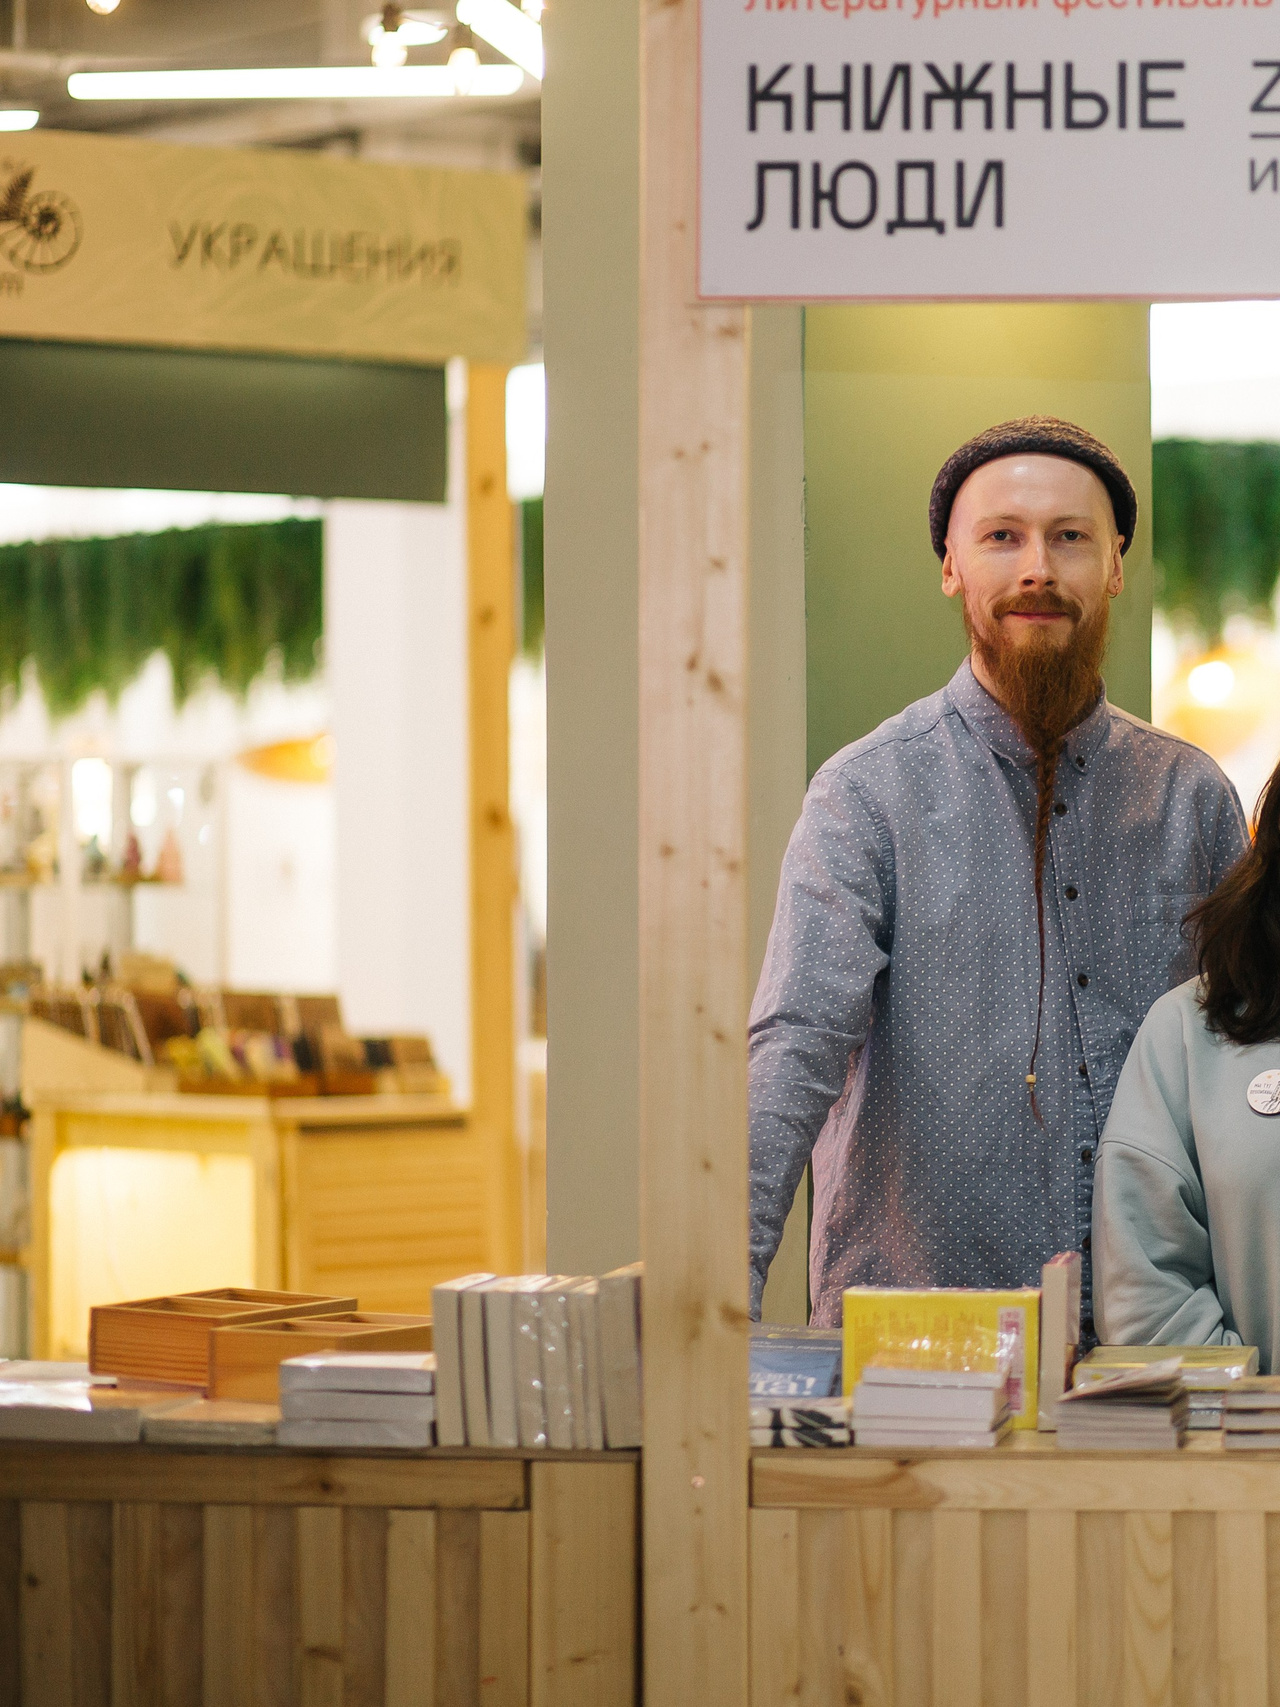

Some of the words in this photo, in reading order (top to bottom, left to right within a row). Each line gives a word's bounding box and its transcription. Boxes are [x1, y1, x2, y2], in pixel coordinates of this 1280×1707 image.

[747, 60, 1186, 132] КНИЖНЫЕ
[746, 159, 1006, 236] ЛЮДИ
[168, 218, 464, 289] УКРАШЕНИЯ
